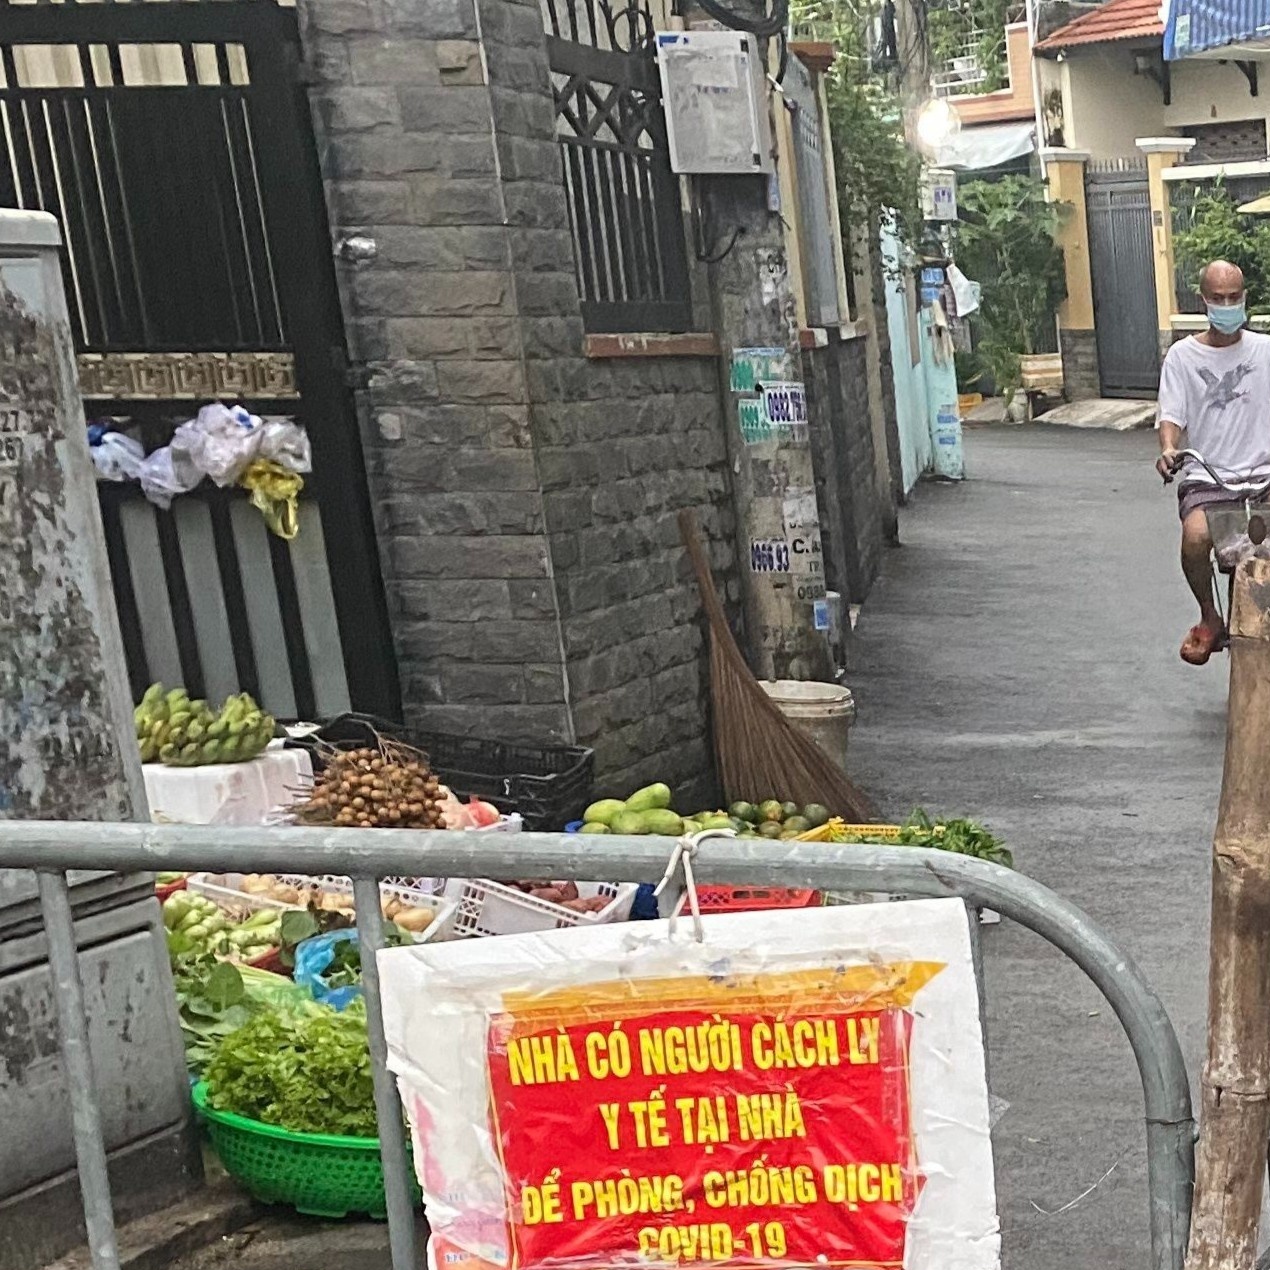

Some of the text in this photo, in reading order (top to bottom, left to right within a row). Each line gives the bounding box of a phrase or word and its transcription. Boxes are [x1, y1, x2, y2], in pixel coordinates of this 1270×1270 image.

[506, 1012, 880, 1085] NHÀ CÓ NGƯỜI CÁCH LY
[599, 1082, 806, 1154] Y TẾ TẠI NHÀ
[521, 1154, 902, 1225] ĐỂ PHÒNG, CHỐNG DỊCH
[638, 1221, 787, 1260] COVID-19
